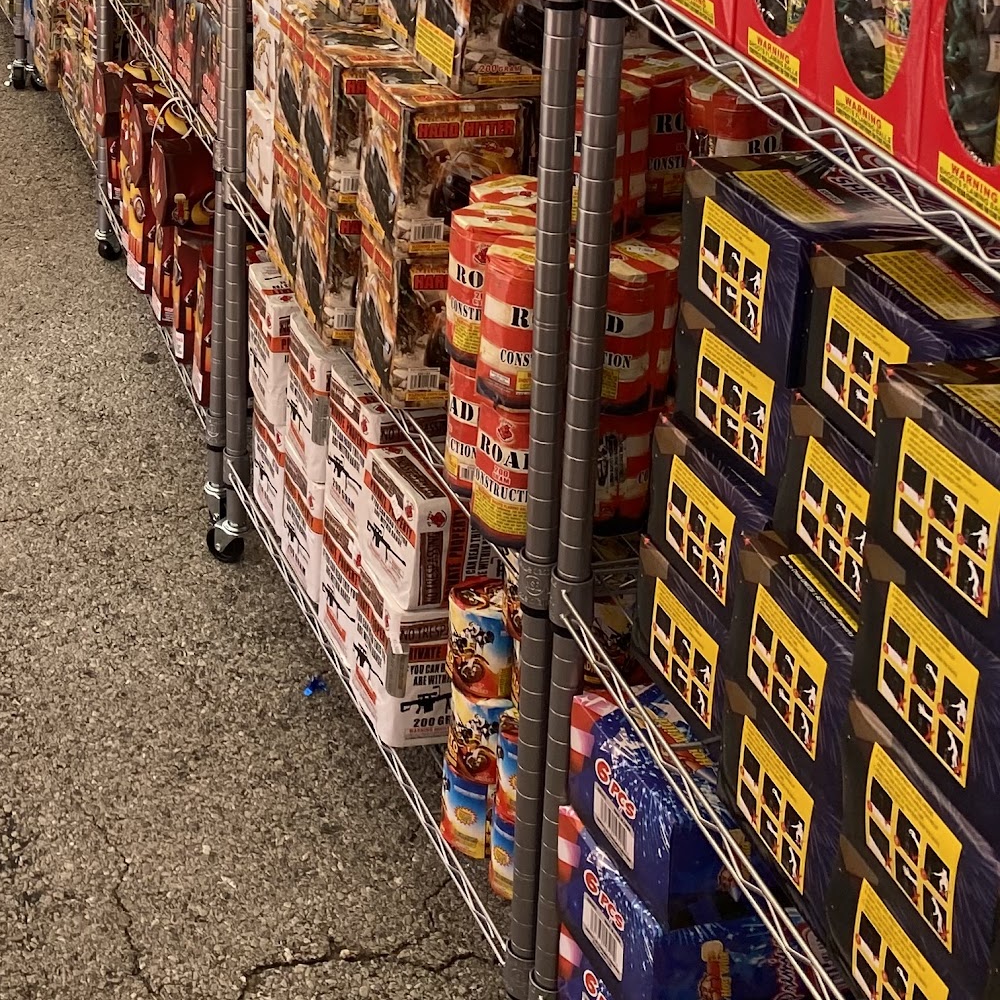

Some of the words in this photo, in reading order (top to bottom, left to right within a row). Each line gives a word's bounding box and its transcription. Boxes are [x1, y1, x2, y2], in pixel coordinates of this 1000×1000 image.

[757, 36, 790, 65] WARNING
[478, 64, 498, 75] 200
[497, 64, 522, 73] GRAM
[844, 95, 882, 130] WARNING
[417, 122, 460, 140] HARD
[463, 118, 516, 138] HITTER
[950, 162, 998, 205] WARNING
[492, 465, 509, 477] 200
[410, 664, 424, 675] YOU
[424, 663, 438, 674] CAN
[413, 675, 427, 686] ARE
[413, 717, 437, 728] 200
[594, 757, 611, 786] 6
[608, 779, 637, 820] PCS
[583, 869, 600, 897] 6
[598, 891, 625, 932] PCS
[583, 968, 599, 998] 6
